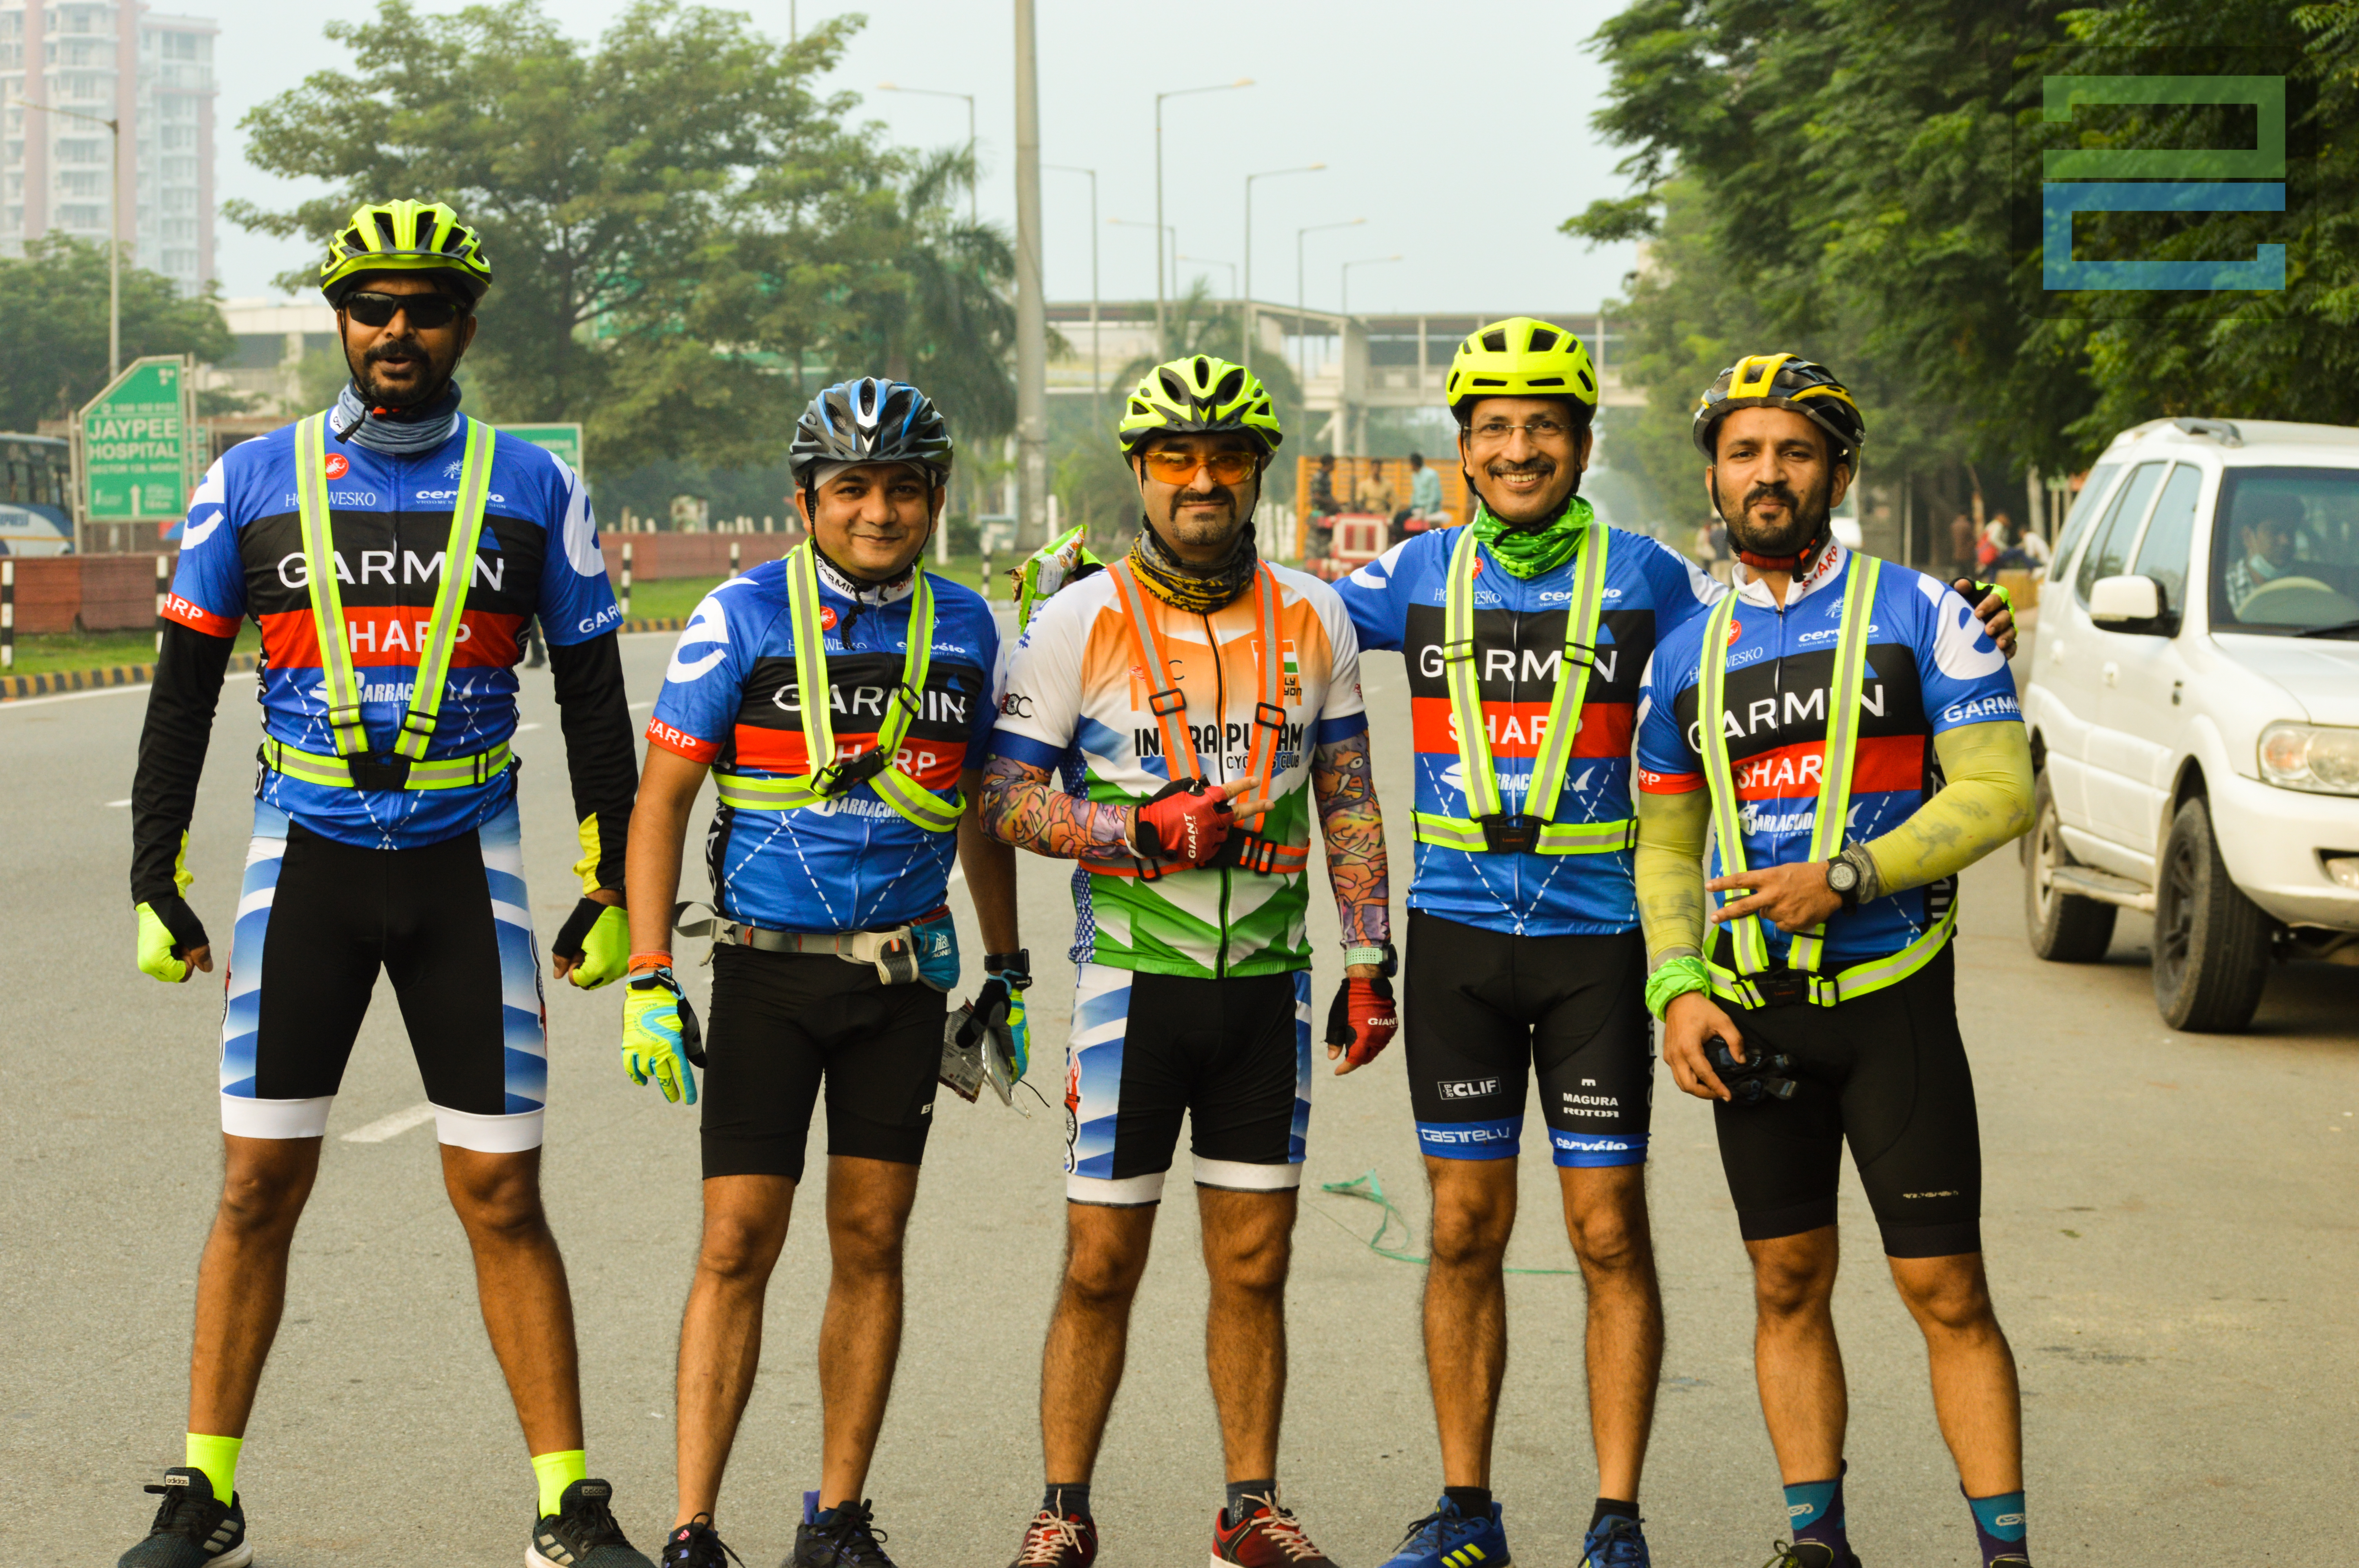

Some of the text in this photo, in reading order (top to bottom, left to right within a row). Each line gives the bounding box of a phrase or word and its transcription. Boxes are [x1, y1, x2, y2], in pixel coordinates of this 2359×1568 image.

[89, 418, 178, 440] JAYPEE
[89, 441, 179, 460] HOSPITAL
[285, 492, 376, 507] HWESKO
[416, 490, 505, 503] cerlo
[277, 550, 504, 592] GARMN
[1539, 588, 1622, 601] cerlo
[349, 620, 471, 653] HAP
[896, 641, 966, 653] cvélo
[1420, 644, 1617, 682] GRMN
[1689, 646, 1763, 681] HWESKO
[1448, 713, 1583, 744] HAR
[1688, 684, 1884, 754] ARMN
[1135, 723, 1303, 756] INRAPAM
[834, 745, 936, 777] HRP
[1227, 756, 1299, 769] CYCG CLUB
[1737, 755, 1823, 789] SHAR
[823, 797, 903, 817] ARRACU
[1183, 813, 1196, 859] GIANT
[1453, 1080, 1496, 1097] CLIF
[1563, 1093, 1619, 1106] MAGURA
